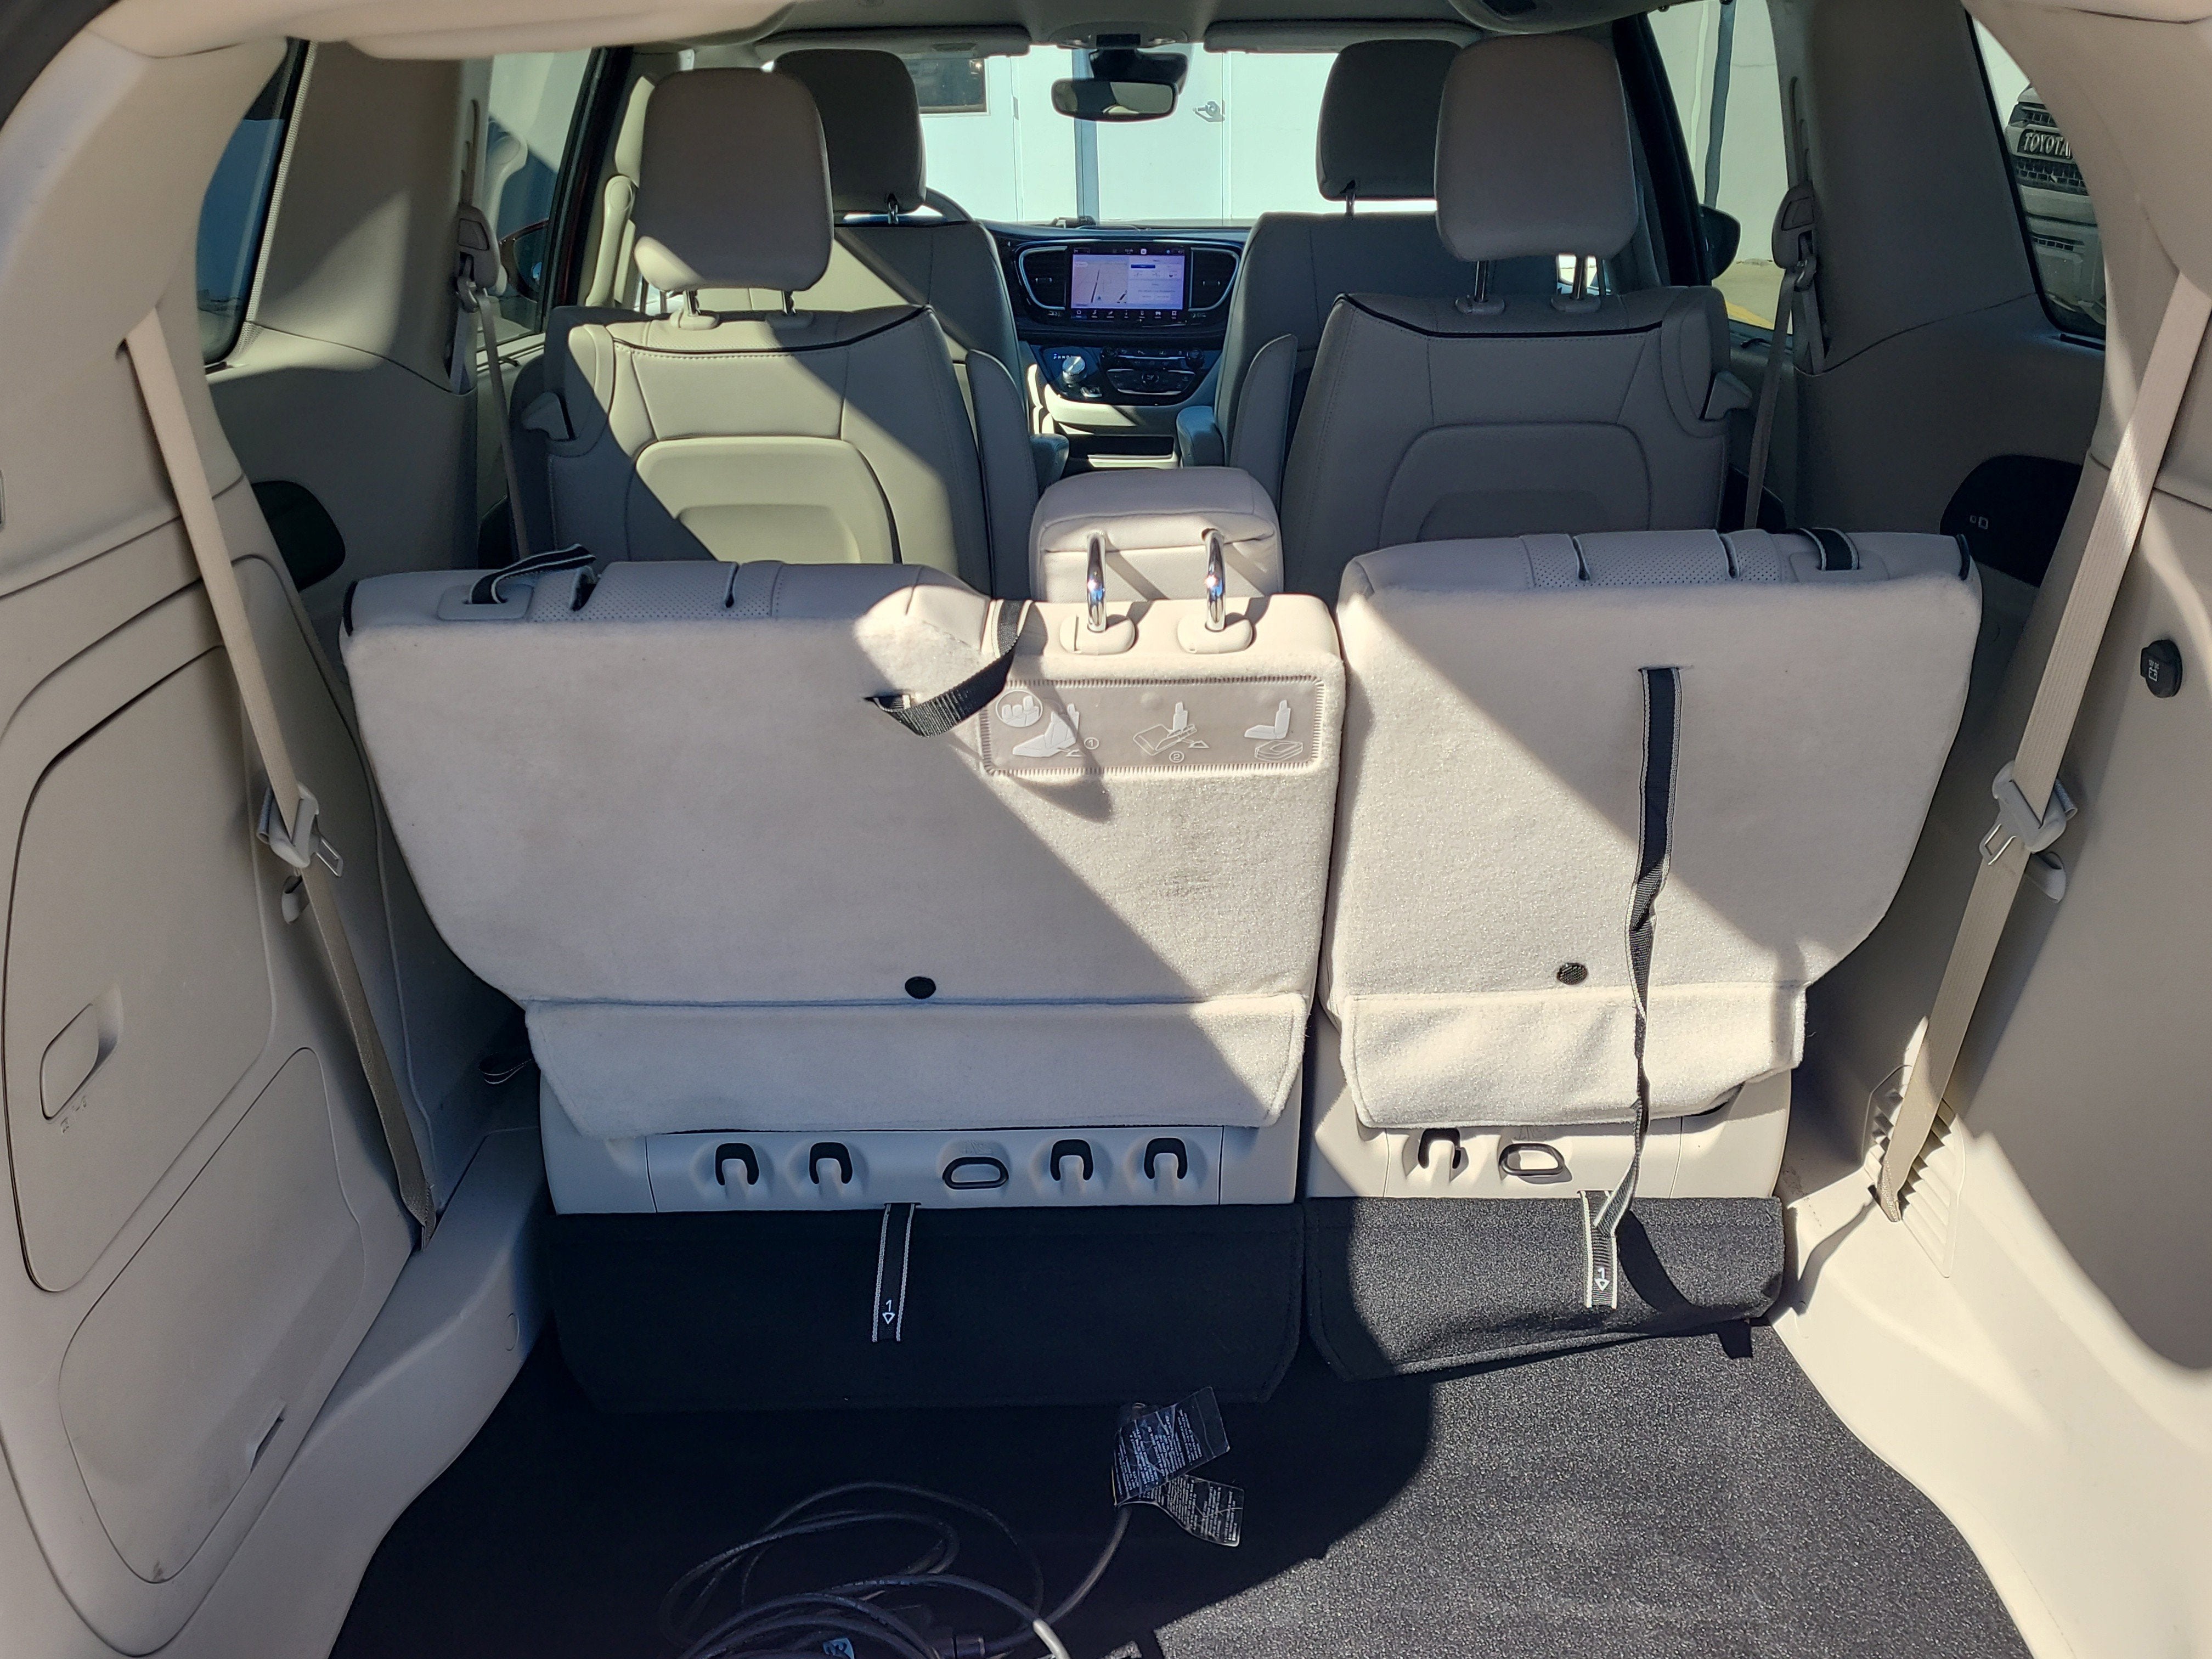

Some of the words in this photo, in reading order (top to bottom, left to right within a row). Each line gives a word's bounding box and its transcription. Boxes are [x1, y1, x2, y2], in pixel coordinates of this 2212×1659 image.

[2024, 132, 2069, 157] TOYOTA
[1598, 1267, 1605, 1279] 1
[885, 1300, 892, 1312] 1
